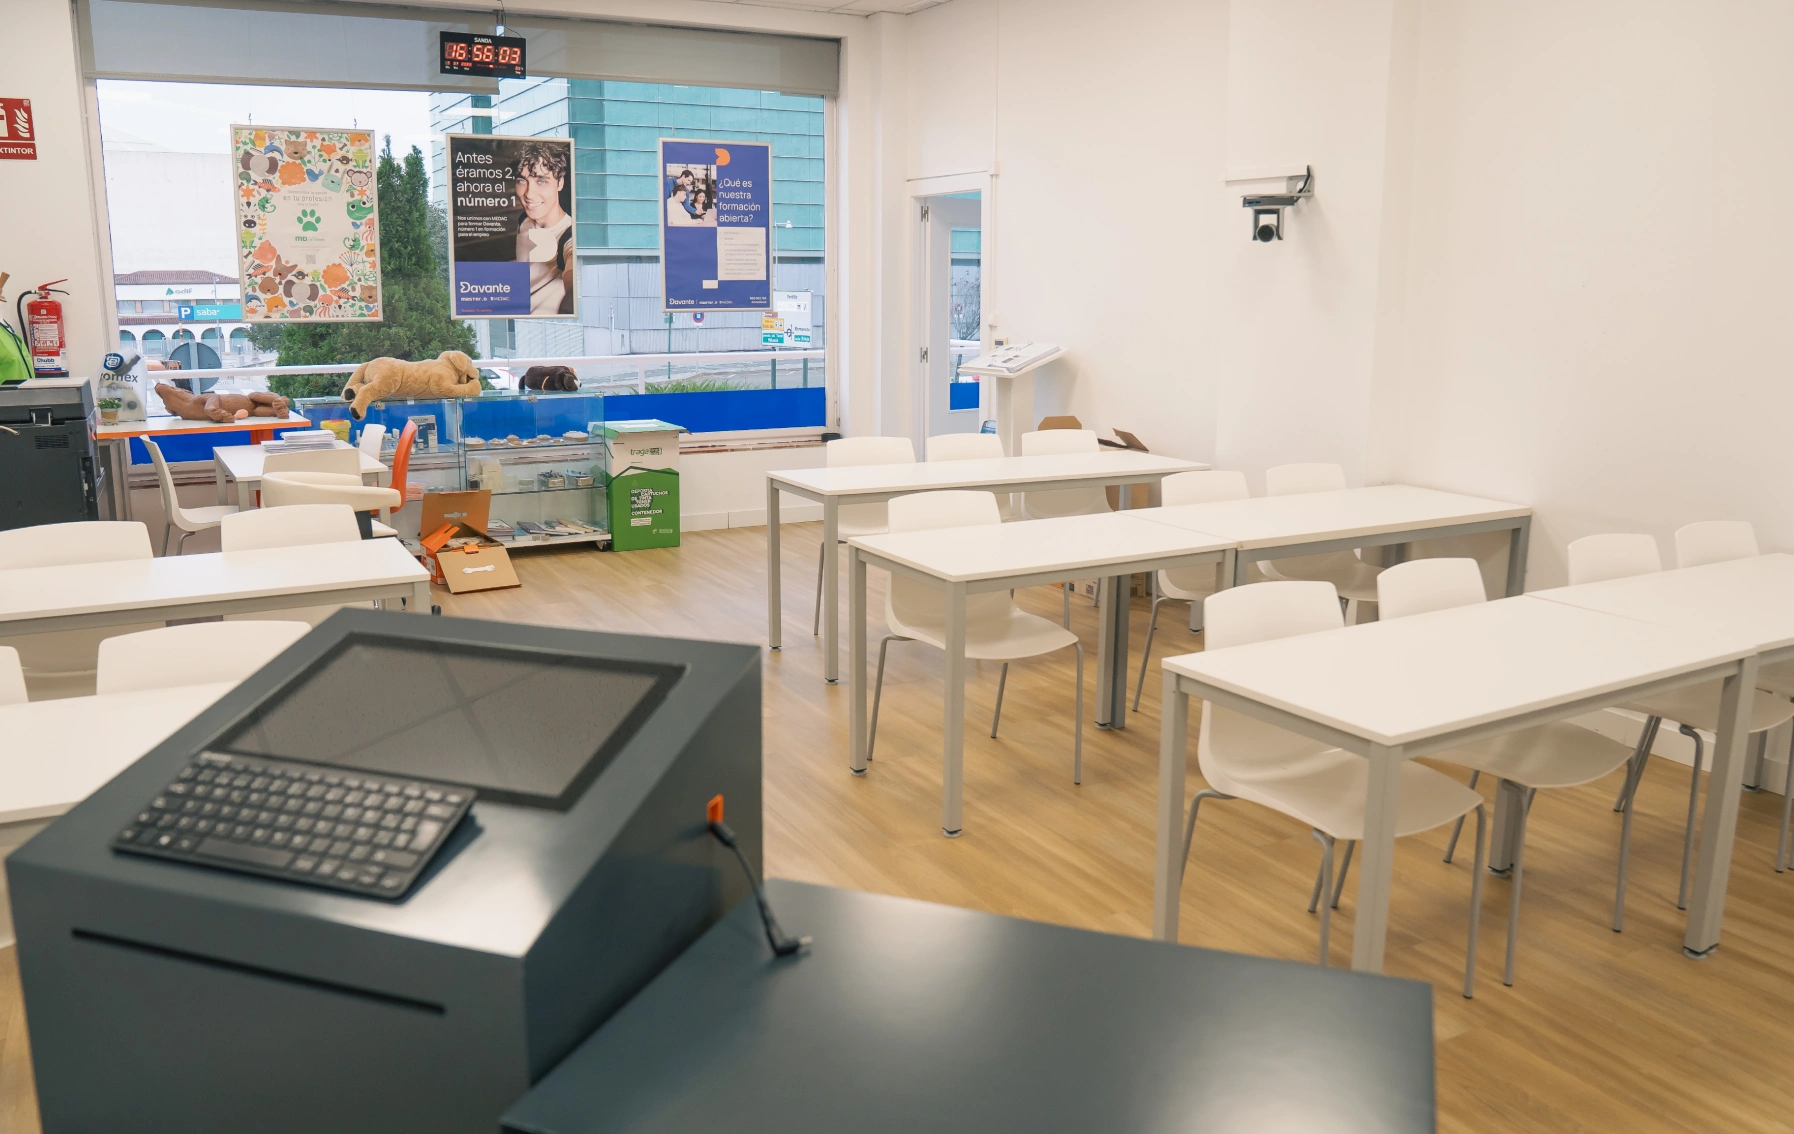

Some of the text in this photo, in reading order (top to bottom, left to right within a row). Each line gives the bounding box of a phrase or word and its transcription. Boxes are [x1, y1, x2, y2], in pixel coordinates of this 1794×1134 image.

[456, 151, 493, 164] Antes
[456, 165, 515, 180] éramos 2,
[456, 180, 506, 193] ahora el
[718, 178, 753, 189] ¿Qué es
[457, 193, 516, 207] número 1
[718, 191, 752, 200] nuestra
[719, 201, 761, 211] formación
[719, 213, 754, 222] abierta?
[460, 281, 511, 293] Davante
[180, 307, 217, 319] P saba
